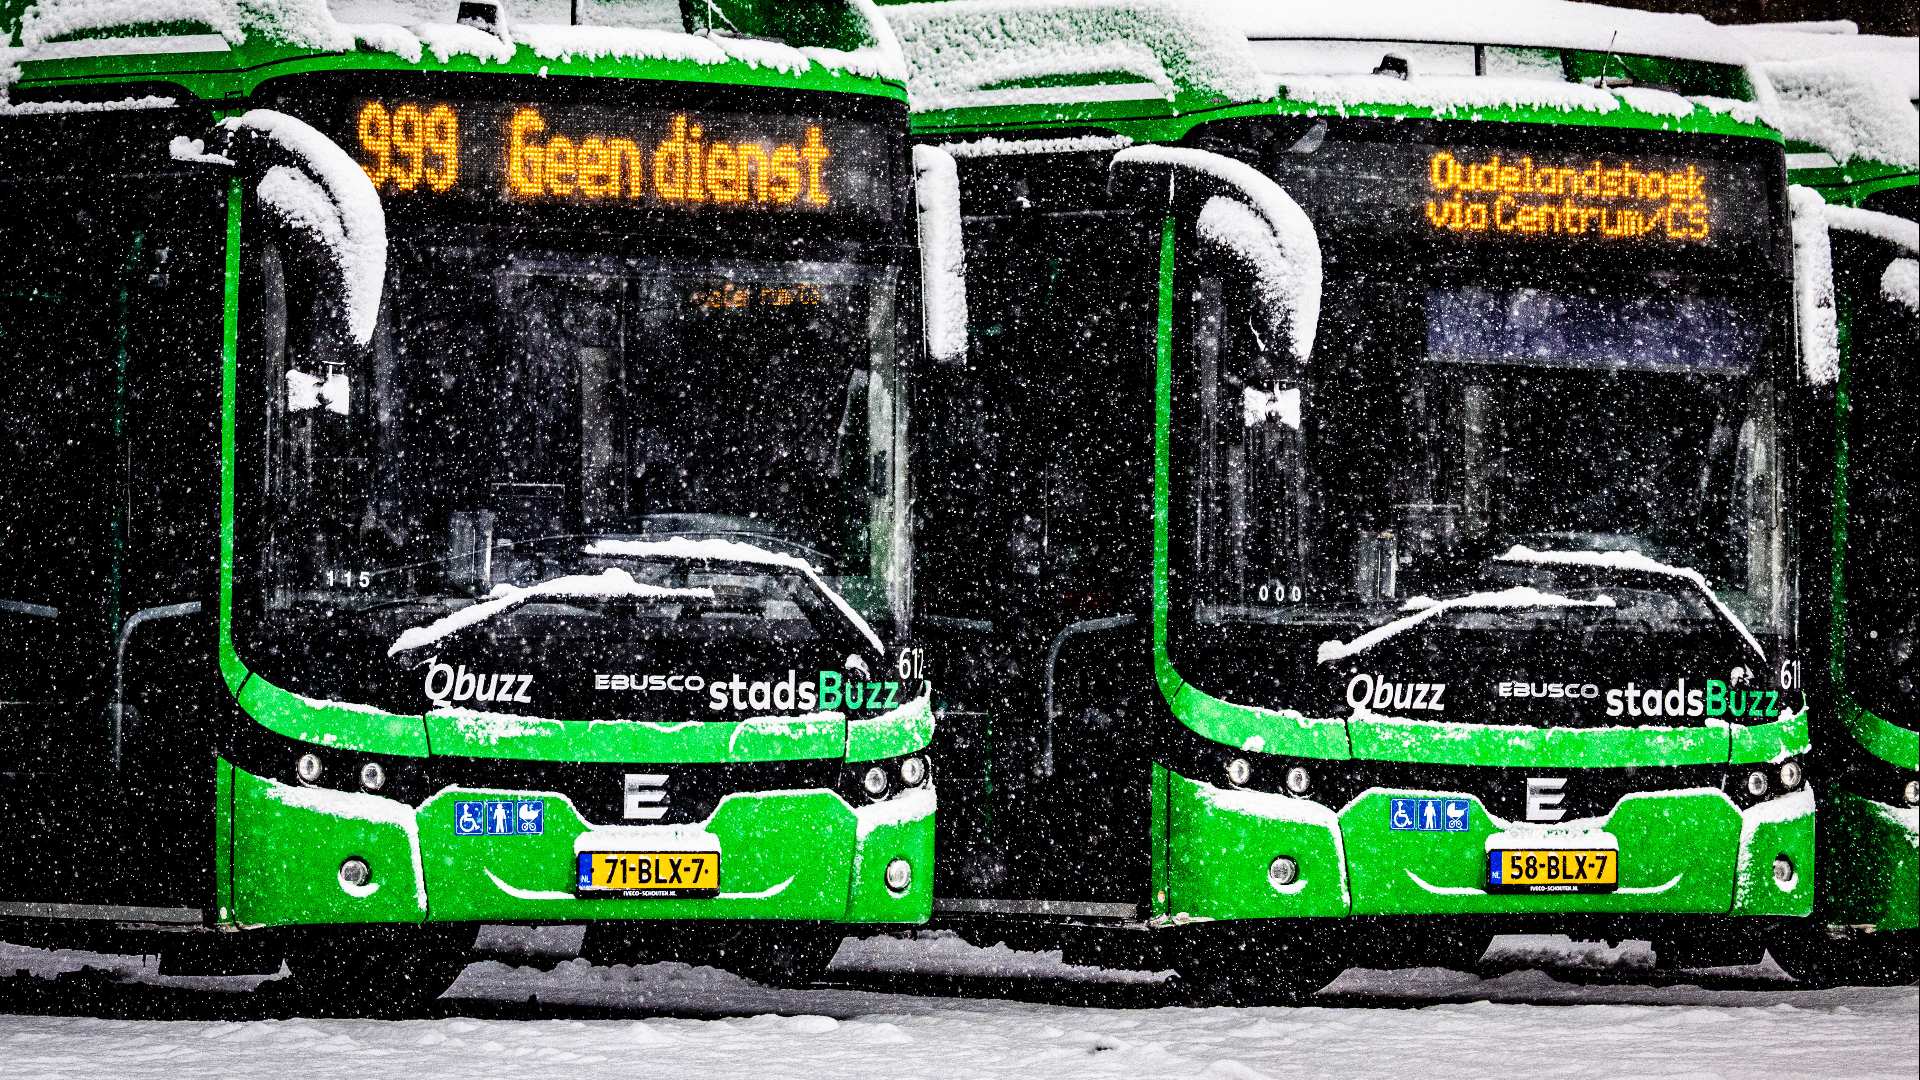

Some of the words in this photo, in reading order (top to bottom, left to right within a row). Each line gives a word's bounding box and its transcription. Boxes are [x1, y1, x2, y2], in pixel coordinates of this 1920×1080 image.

[358, 102, 459, 192] 999
[509, 107, 642, 198] Geen
[654, 114, 830, 205] dienst
[1431, 152, 1706, 201] Oudelandshoek
[1427, 193, 1487, 230] via
[1495, 195, 1709, 239] Centrum/CS
[899, 647, 924, 680] 612
[1780, 659, 1801, 690] 611
[424, 664, 534, 706] Qbuzz
[594, 674, 705, 691] EBUSCO
[708, 669, 899, 711] stadsBuzz
[1346, 673, 1446, 711] Qbuzz
[1498, 682, 1599, 698] EBUSCO
[1606, 678, 1779, 717] stadsBuzz
[580, 875, 591, 883] NL
[604, 858, 705, 884] 71-BLX-7
[1491, 871, 1501, 879] NL
[1510, 855, 1608, 880] 58-BLX-7
